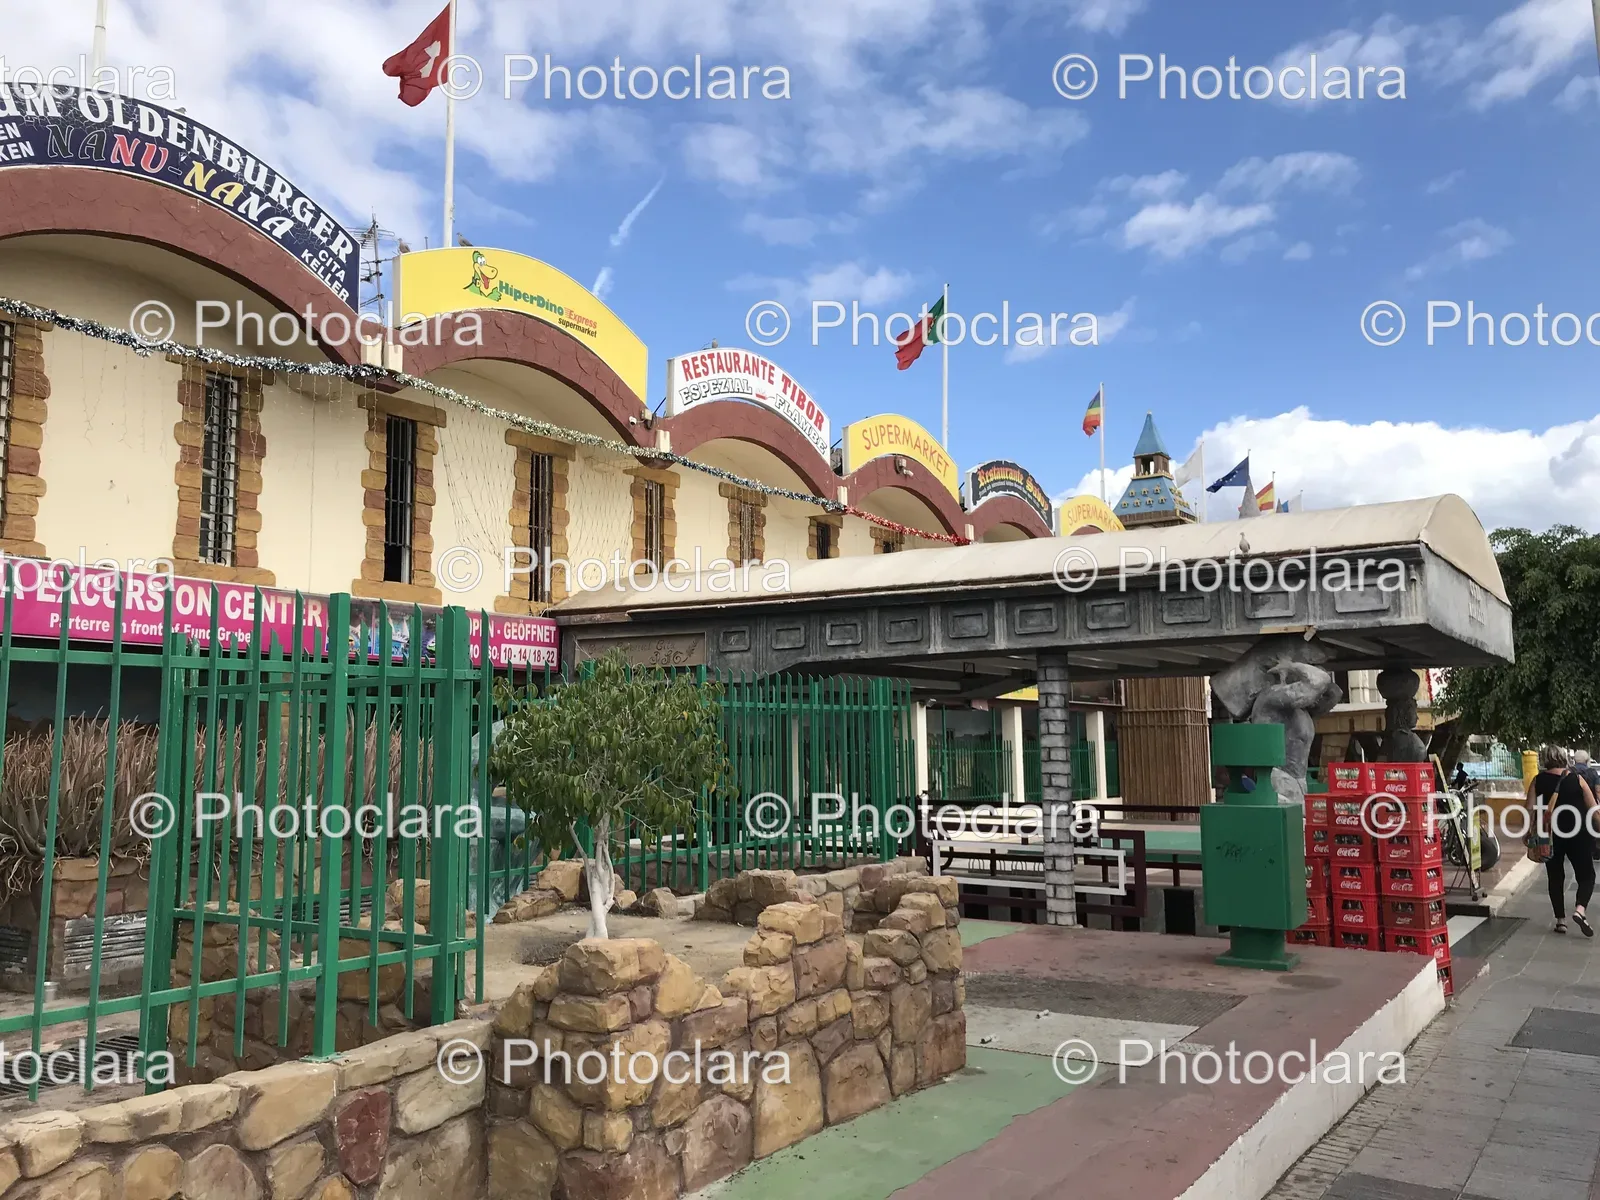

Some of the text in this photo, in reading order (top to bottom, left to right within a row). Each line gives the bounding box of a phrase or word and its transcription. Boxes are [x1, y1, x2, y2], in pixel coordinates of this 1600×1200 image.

[78, 91, 354, 263] OLDENBURGER
[300, 248, 350, 303] KELLER
[318, 248, 347, 283] CITA
[499, 279, 564, 317] HiperDino
[679, 377, 753, 406] ESPEZIAL
[681, 351, 825, 431] RESTAURANTE TIBOR
[861, 423, 950, 479] SUPERMARKET
[1067, 503, 1121, 531] SUPERMARK
[36, 570, 211, 617] EXCURSON
[130, 619, 163, 636] front
[217, 626, 251, 643] Grbe
[503, 619, 557, 643] GEÖFFNET
